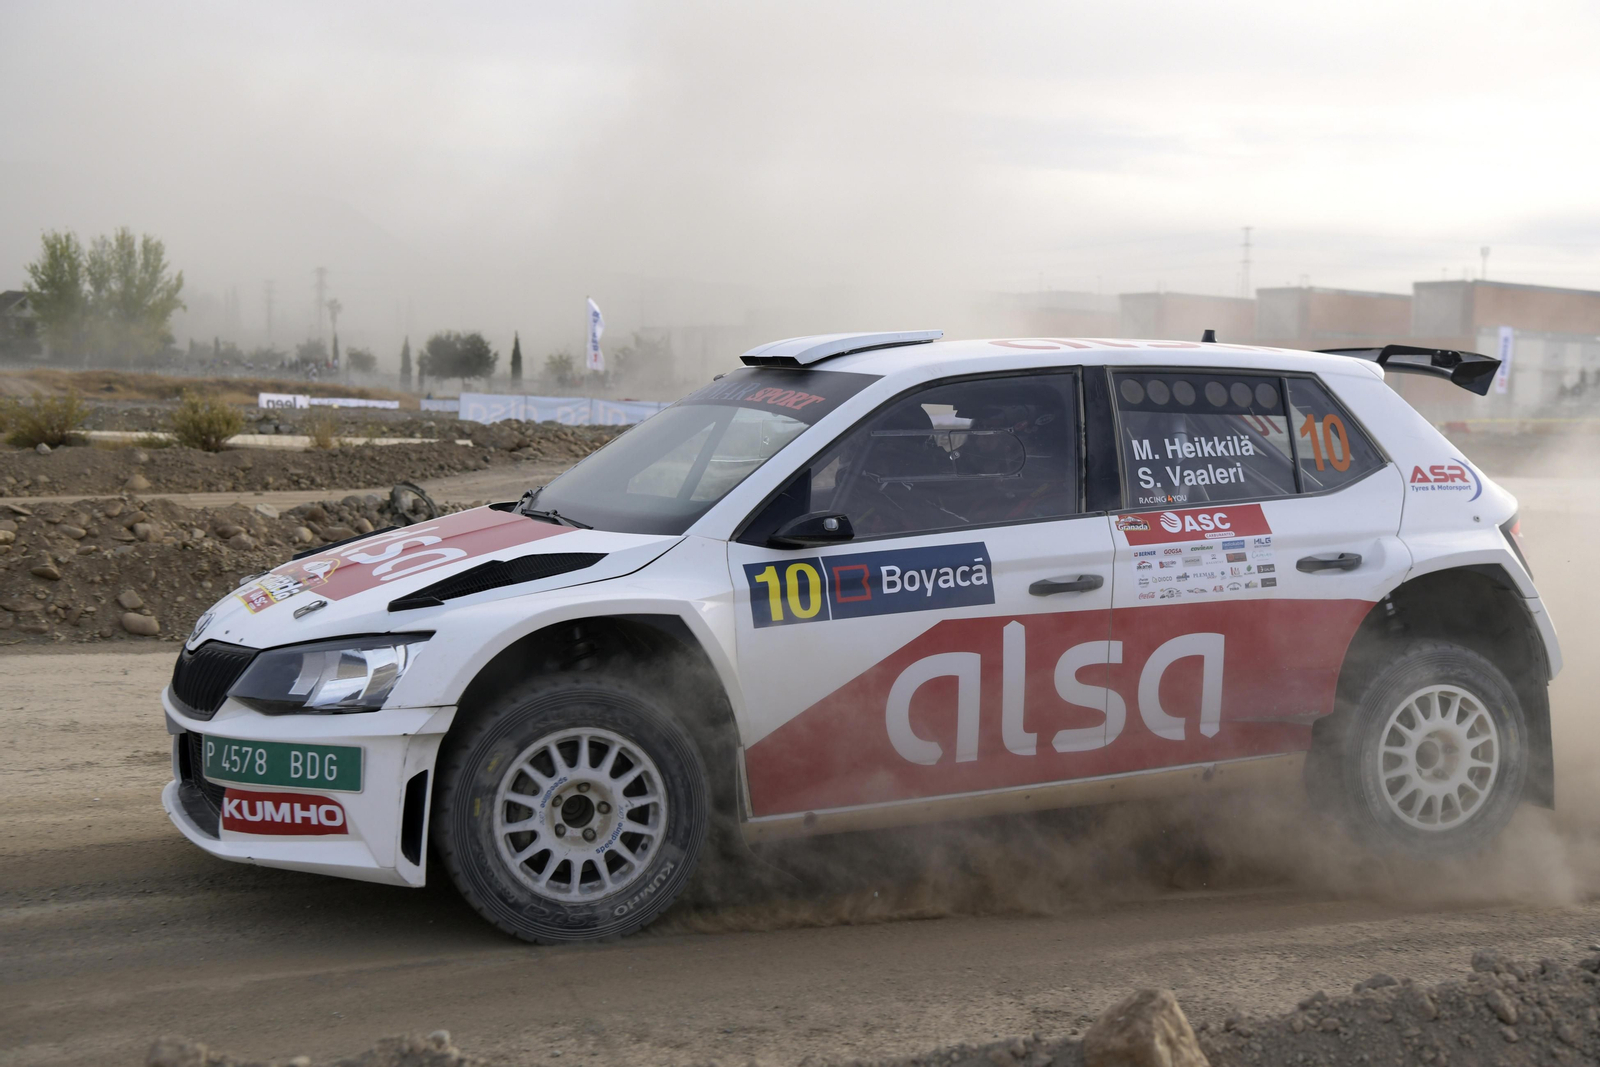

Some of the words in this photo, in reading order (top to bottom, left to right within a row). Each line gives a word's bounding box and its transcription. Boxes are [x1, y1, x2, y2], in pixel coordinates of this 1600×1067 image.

[744, 387, 826, 410] SPORT
[1131, 439, 1160, 460] M.
[1164, 435, 1255, 460] Heikkilä
[1300, 414, 1351, 472] 10
[1137, 467, 1161, 489] S.
[1165, 463, 1245, 487] Vaaleri
[1410, 465, 1470, 483] ASR
[1118, 523, 1148, 531] Granada
[1184, 513, 1231, 532] ASC
[754, 563, 822, 622] 10
[880, 557, 988, 597] Boyacá
[885, 620, 1226, 766] alsa
[207, 741, 215, 768] P
[222, 744, 267, 775] 4578
[290, 750, 337, 781] BDG
[540, 776, 567, 808] speedline
[223, 796, 344, 827] KUMHO
[595, 822, 624, 854] speedline
[614, 861, 675, 917] KUMHO
